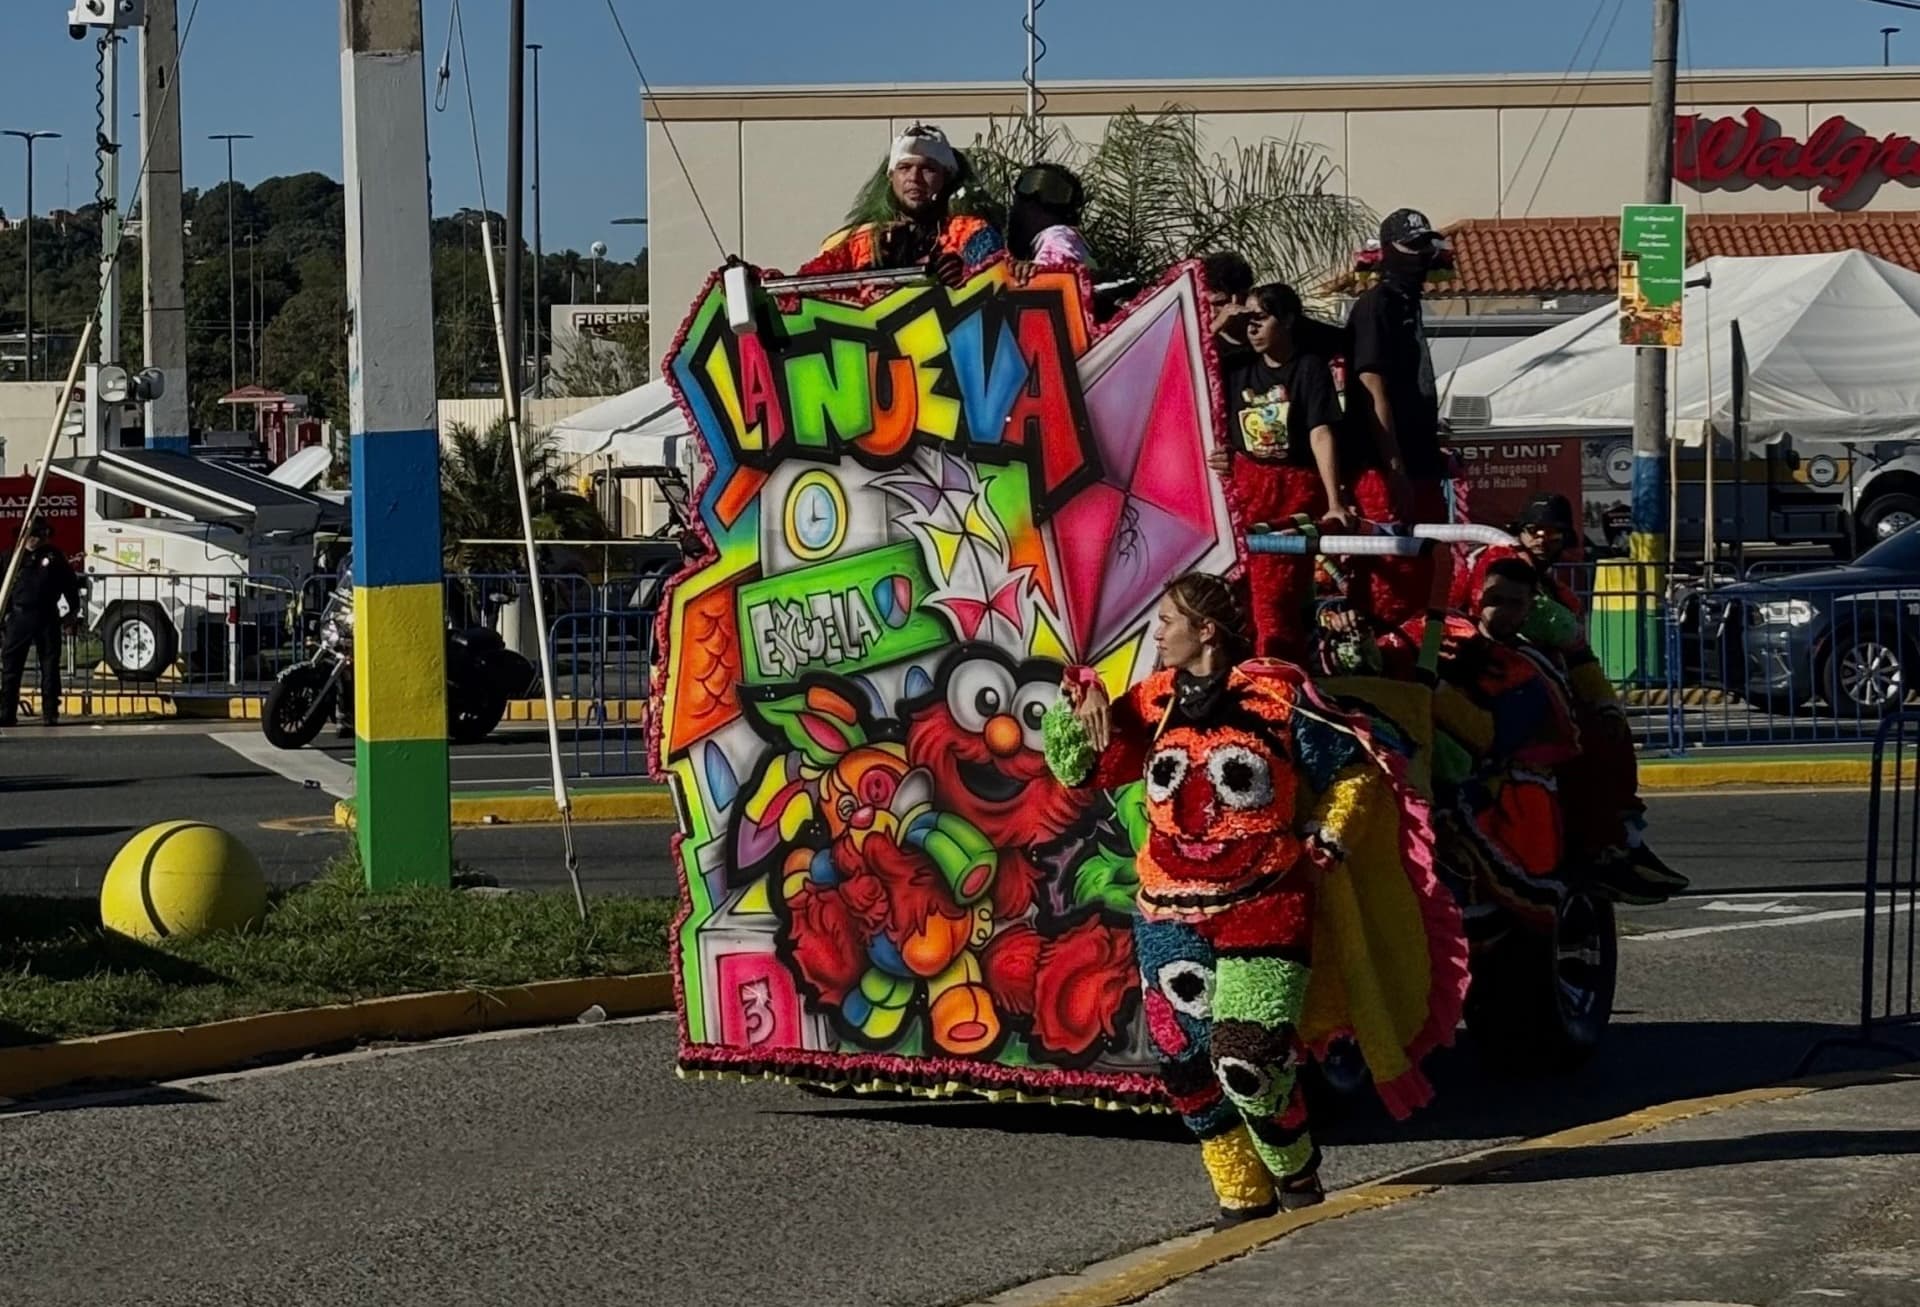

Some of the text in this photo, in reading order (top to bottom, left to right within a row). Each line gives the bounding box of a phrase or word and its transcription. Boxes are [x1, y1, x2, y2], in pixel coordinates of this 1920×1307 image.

[704, 307, 1087, 494] LA NUEVA
[1484, 462, 1548, 477] Emergencias
[1502, 443, 1562, 459] UNIT
[747, 585, 884, 678] ESCUELA
[739, 975, 776, 1047] 3
